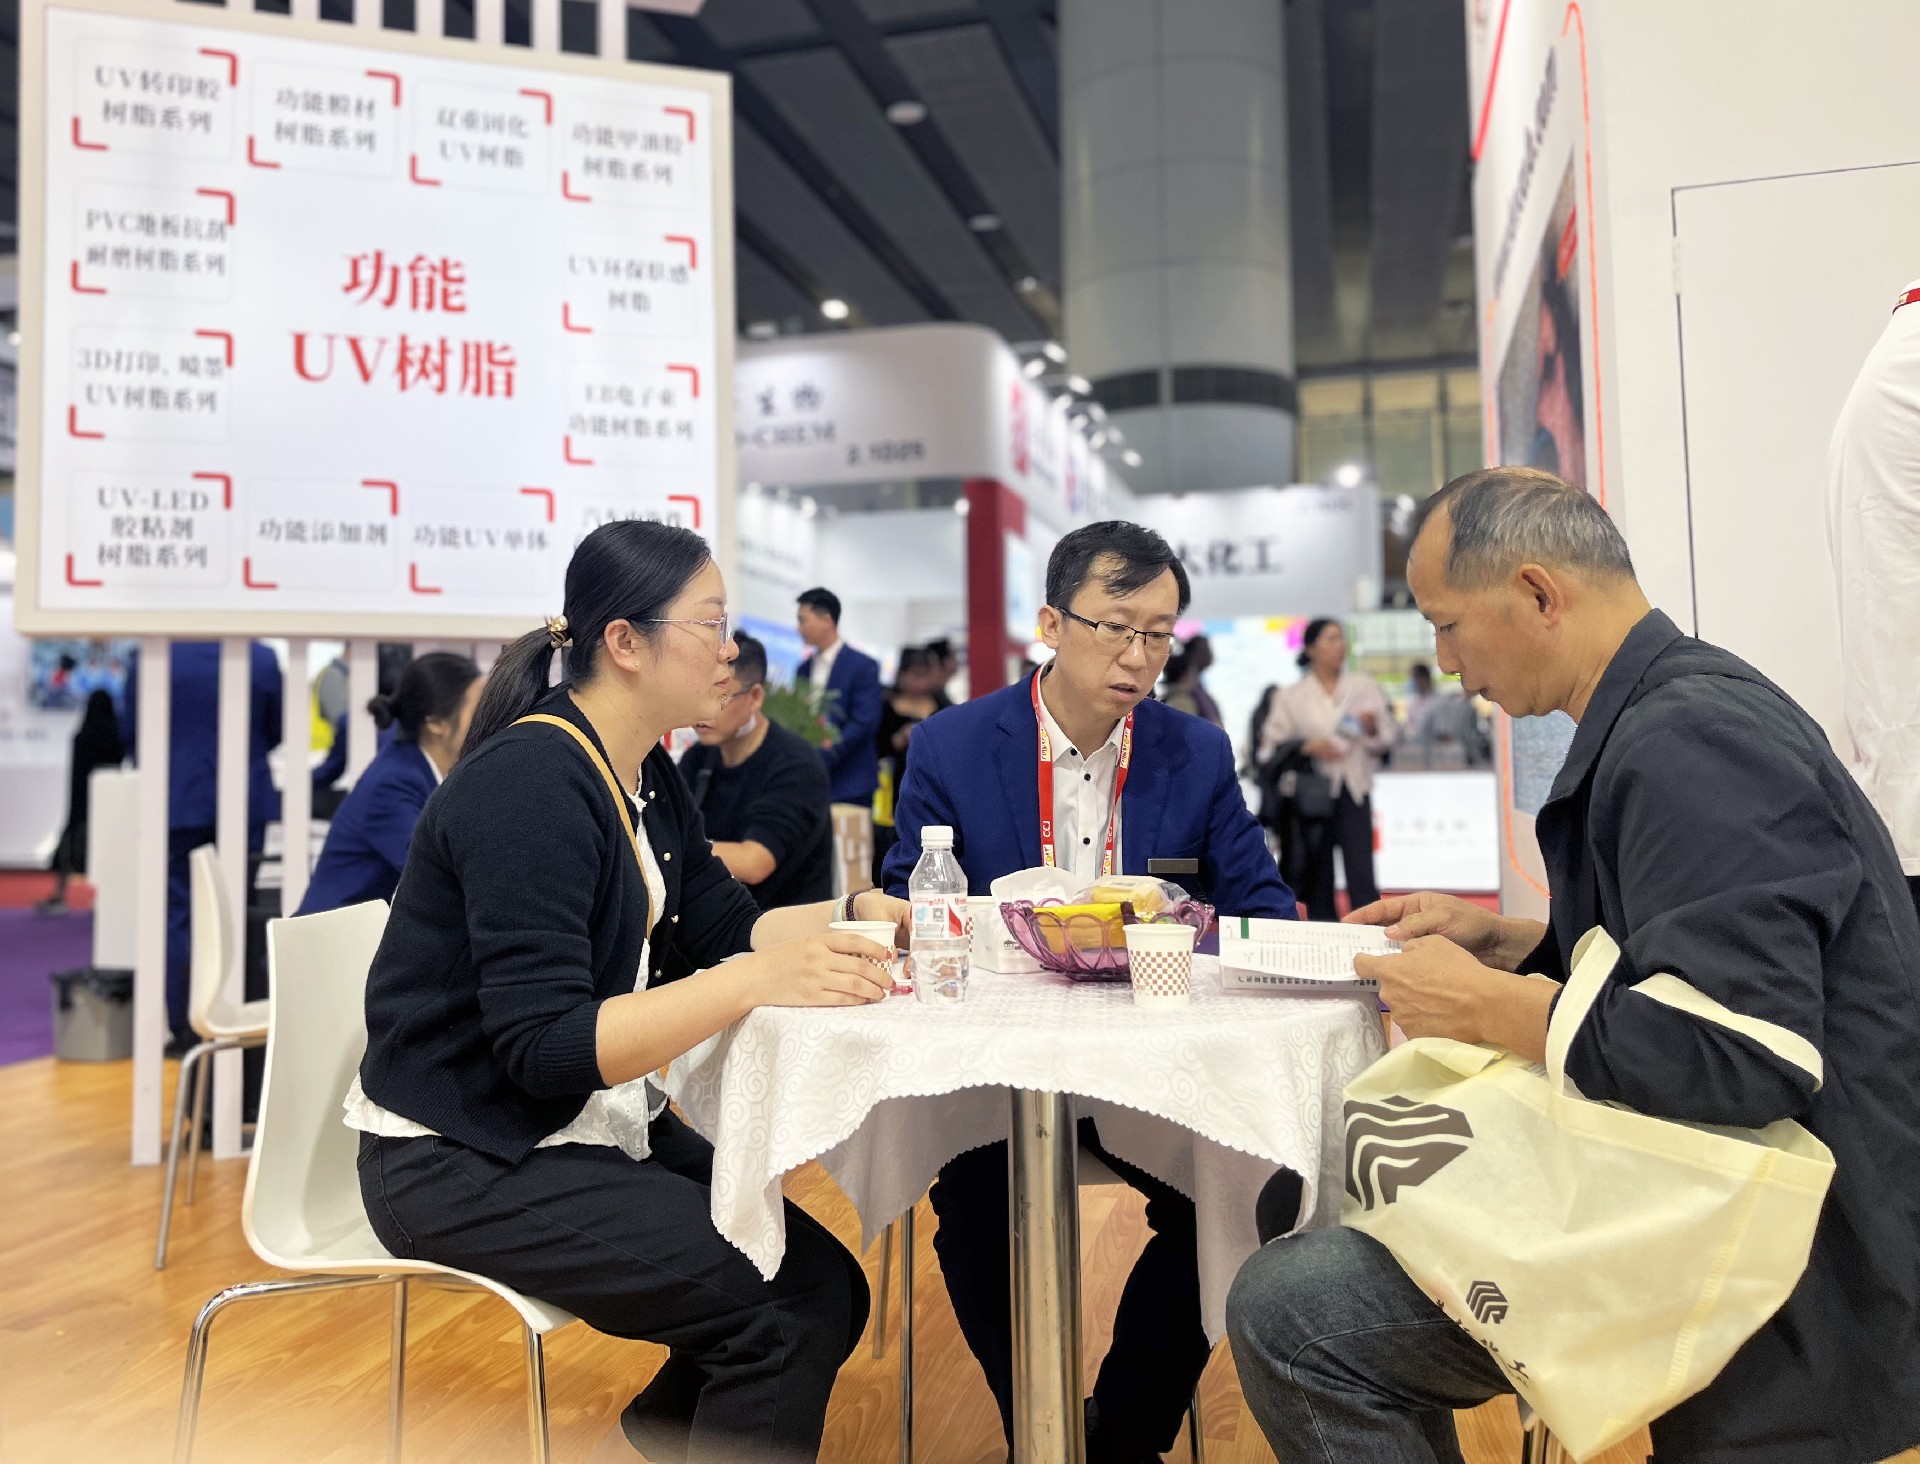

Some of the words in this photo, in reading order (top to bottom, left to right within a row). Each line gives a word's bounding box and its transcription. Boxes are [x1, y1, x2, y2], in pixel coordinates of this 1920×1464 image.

[102, 100, 212, 133] 树脂系列
[275, 120, 377, 152] 树脂系列
[440, 141, 524, 168] UV树脂
[583, 156, 674, 184] 树脂系列
[342, 250, 466, 311] 功能
[608, 290, 650, 313] 树脂
[290, 331, 516, 398] UV树脂
[86, 384, 217, 413] UV树脂系列
[98, 487, 209, 511] UV-LED
[97, 543, 208, 569] 树脂系列
